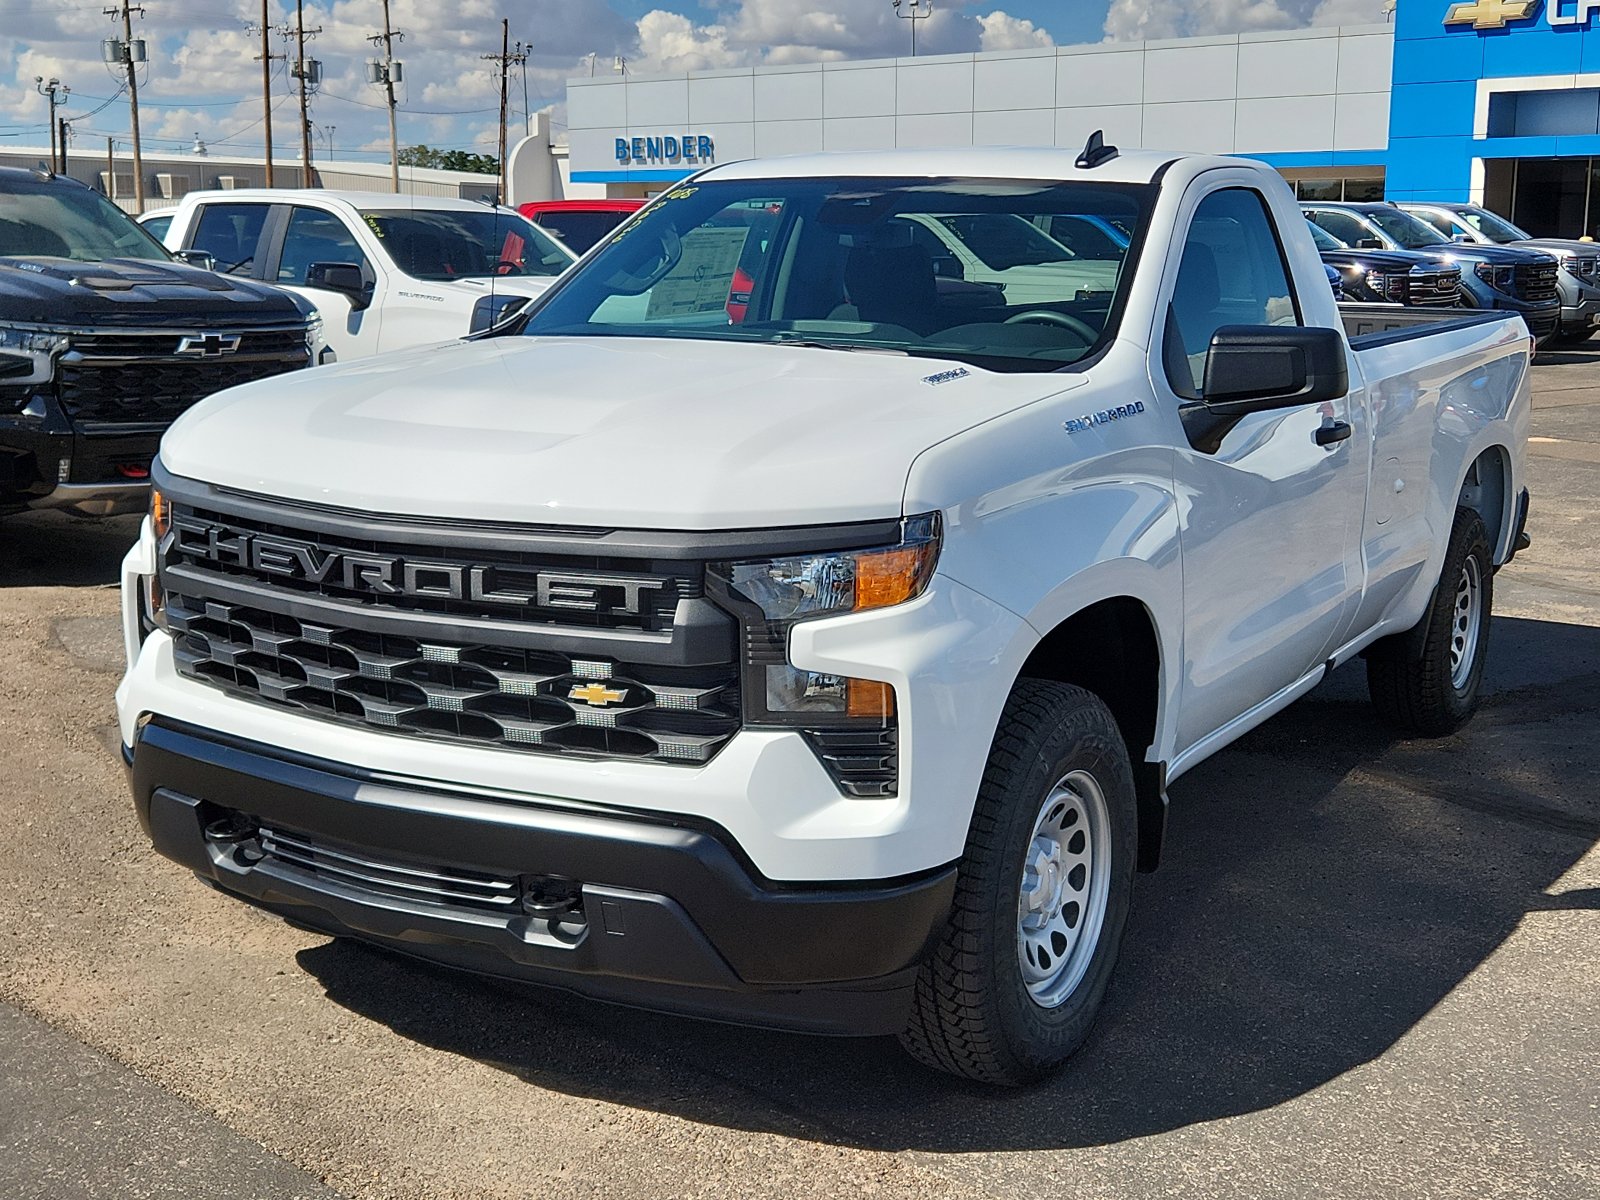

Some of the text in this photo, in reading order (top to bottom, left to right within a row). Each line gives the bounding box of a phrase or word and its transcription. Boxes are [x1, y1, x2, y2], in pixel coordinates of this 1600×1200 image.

[615, 135, 711, 160] BENDER
[398, 291, 445, 302] SILVERADO
[1063, 401, 1145, 434] SILVERADO
[172, 517, 664, 614] CHEVROLET
